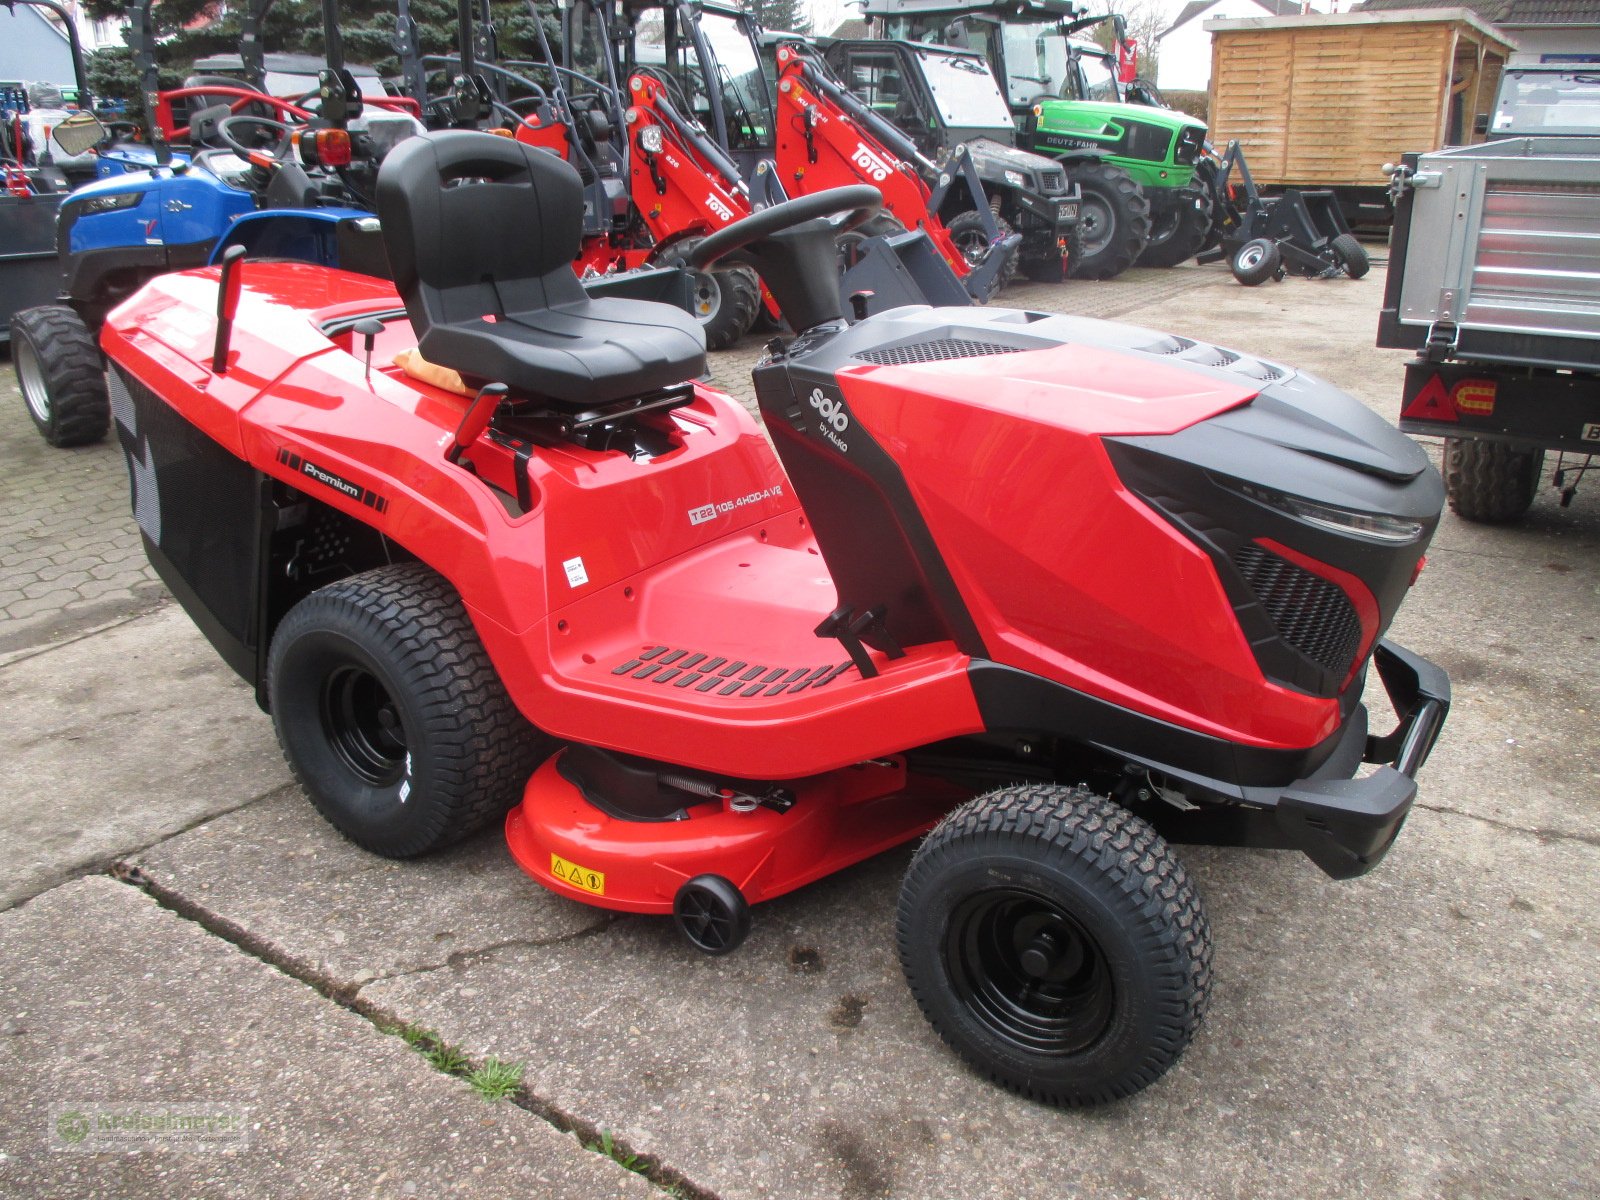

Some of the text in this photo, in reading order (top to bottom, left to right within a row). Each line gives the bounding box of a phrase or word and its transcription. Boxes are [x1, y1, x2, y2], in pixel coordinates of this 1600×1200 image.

[1047, 137, 1098, 149] DEUTZ-FAHR
[851, 142, 893, 181] TOYO
[705, 192, 734, 221] TOYO
[809, 388, 849, 432] solo
[819, 422, 848, 453] by AL-KO
[304, 462, 358, 497] Premium
[700, 507, 714, 519] 22
